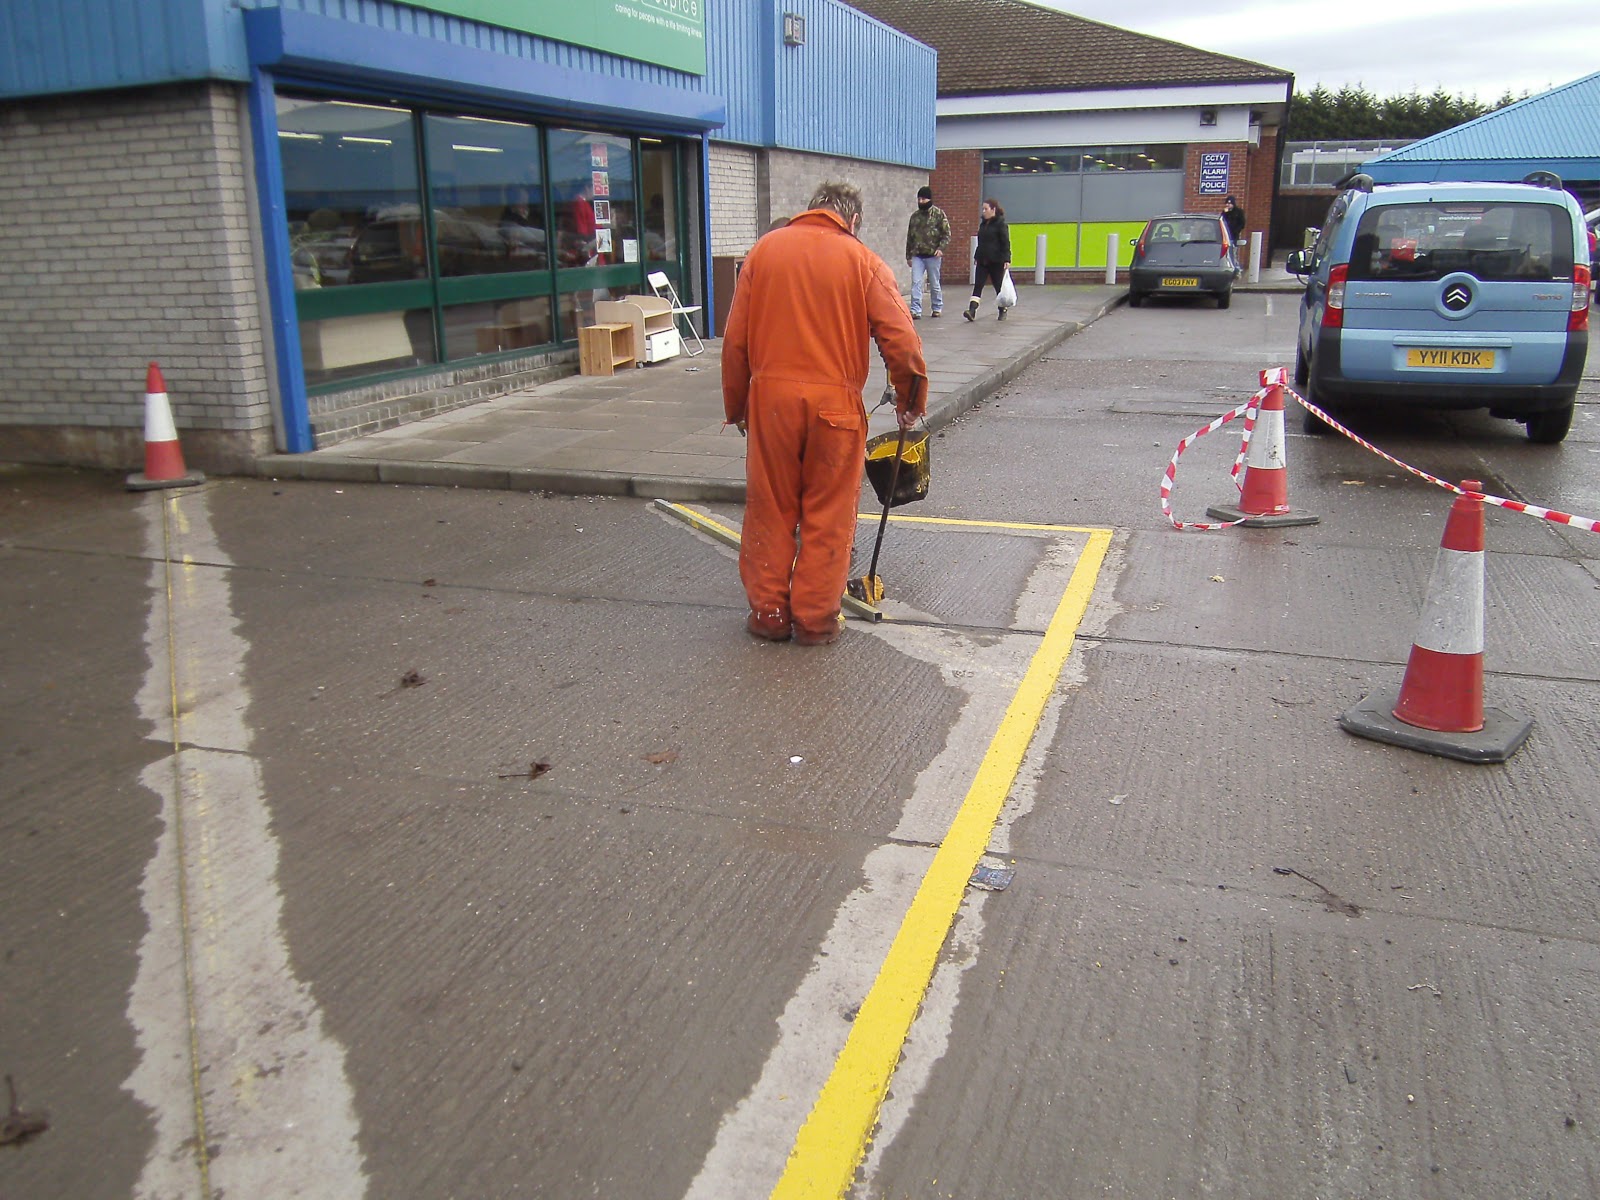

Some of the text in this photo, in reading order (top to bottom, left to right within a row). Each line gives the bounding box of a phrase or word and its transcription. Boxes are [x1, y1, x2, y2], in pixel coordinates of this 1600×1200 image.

[615, 4, 631, 18] caring
[638, 11, 655, 23] people
[1420, 350, 1481, 365] YY11 KDK
